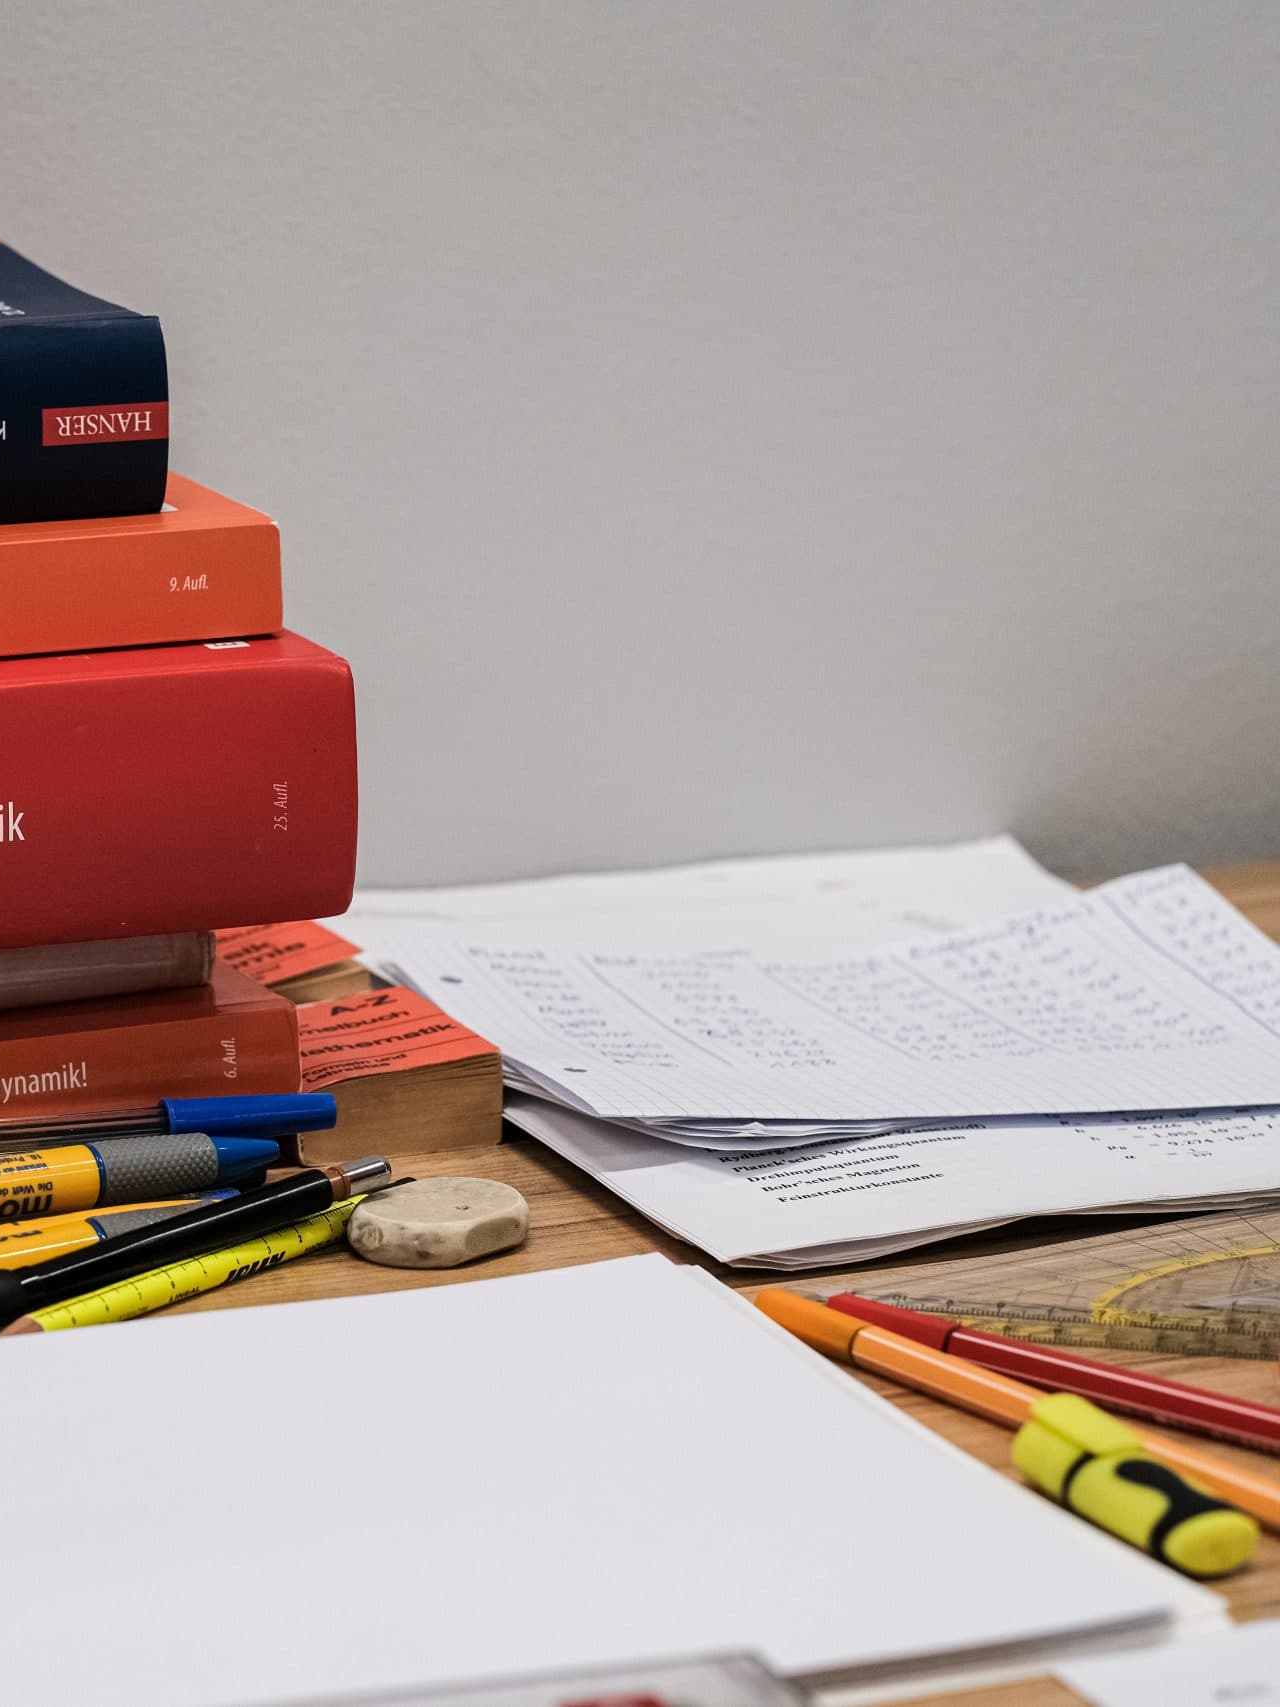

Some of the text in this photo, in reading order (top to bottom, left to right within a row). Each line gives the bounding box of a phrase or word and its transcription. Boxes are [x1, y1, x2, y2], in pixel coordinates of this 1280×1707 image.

[56, 411, 152, 437] HANSER
[170, 574, 209, 592] 9. Aufl.
[273, 779, 289, 832] 25. Aufl.
[331, 995, 398, 1017] A-Z
[300, 1023, 457, 1058] athematik
[223, 1036, 237, 1079] 6. Aufl.
[827, 1135, 966, 1155] Wirkungsquantum
[747, 1154, 900, 1182] Drehimpulsquantum
[846, 1163, 921, 1178] Magneton
[12, 1184, 34, 1195] Welt
[38, 1181, 53, 1191] Die
[777, 1172, 944, 1203] Feinstrukturkonstante
